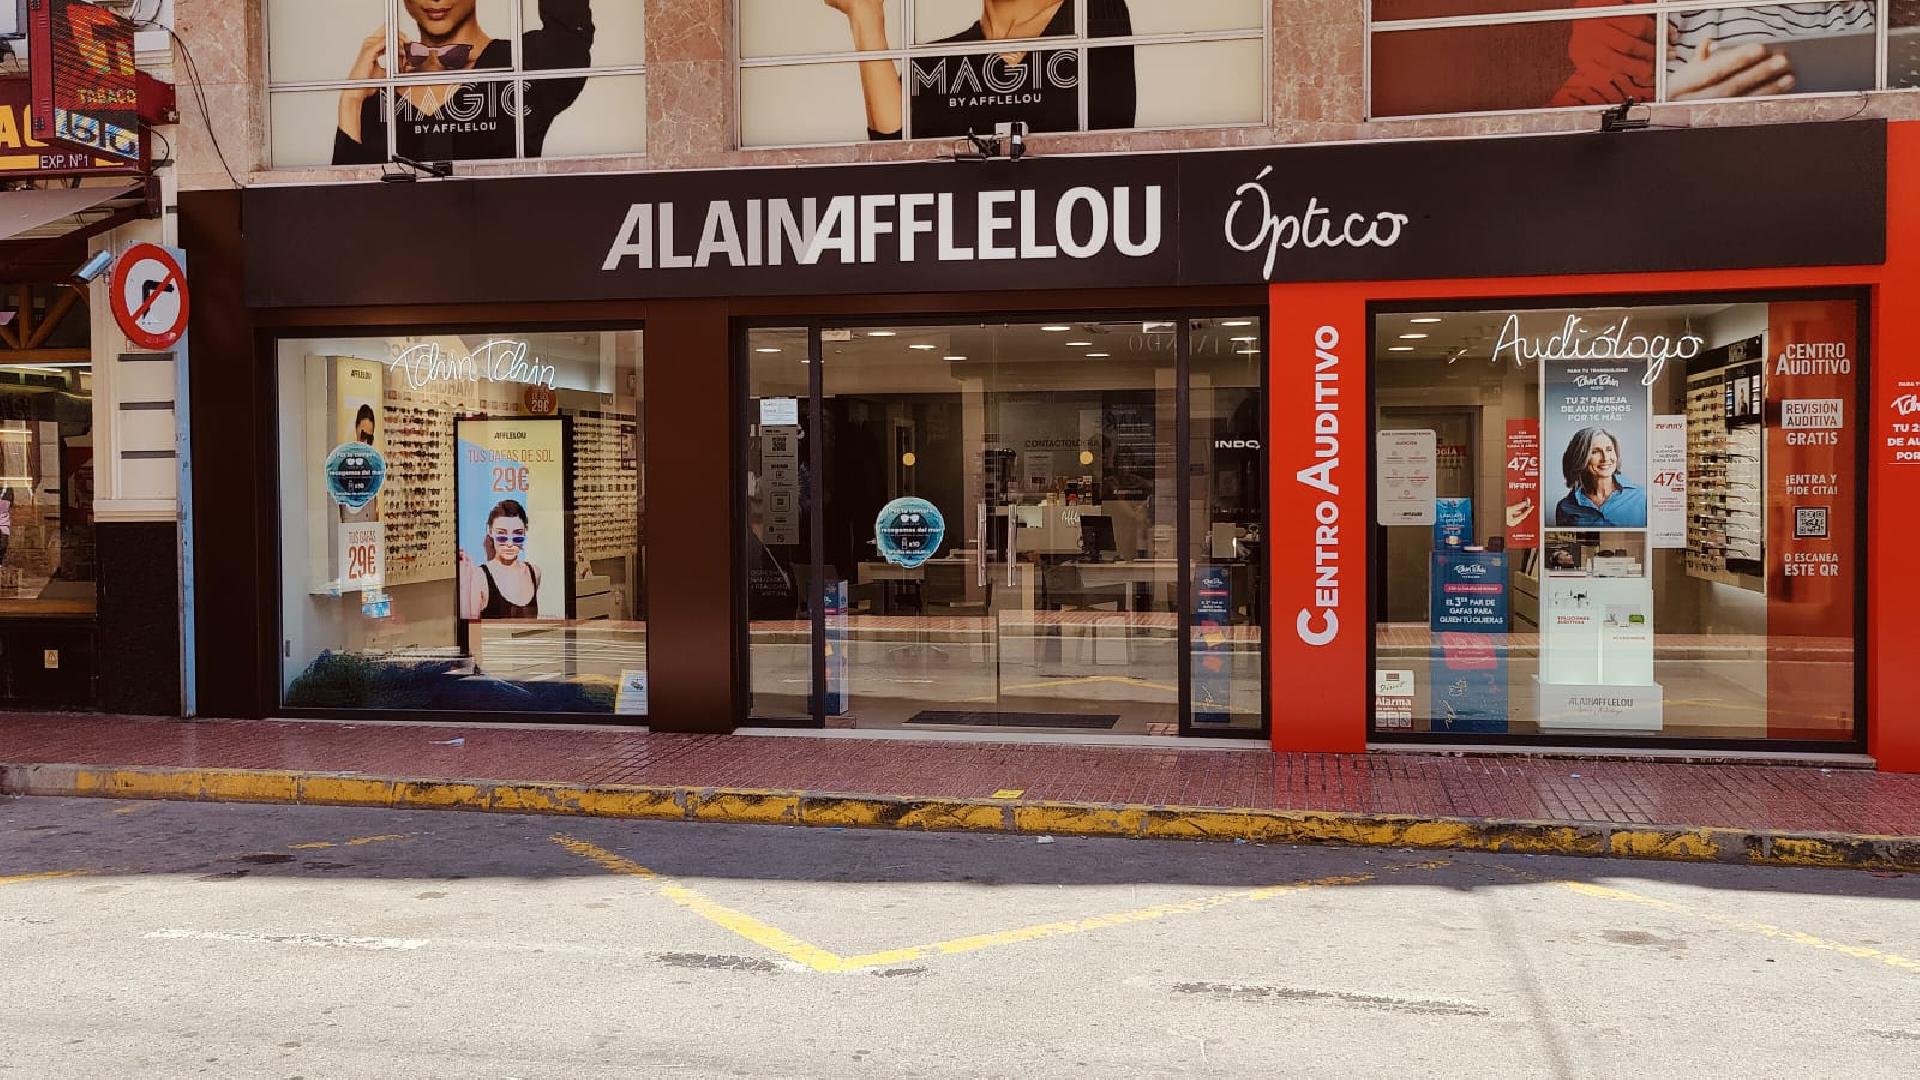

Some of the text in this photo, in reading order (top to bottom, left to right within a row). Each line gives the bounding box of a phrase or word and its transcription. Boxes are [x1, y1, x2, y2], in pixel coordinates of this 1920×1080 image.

[912, 50, 1078, 96] MAGIC
[380, 80, 532, 122] MAGIC
[949, 93, 1042, 107] BY AFFLELOU
[414, 121, 497, 135] BY AFFLELOU
[41, 156, 67, 169] EXP.
[1225, 165, 1409, 280] Óptico
[1491, 314, 1704, 386] Audiólogo
[1785, 342, 1845, 359] CENTRO
[1775, 353, 1851, 376] AUDITIVO
[1591, 396, 1628, 405] PAREJA
[1785, 401, 1838, 415] REVISIÓN
[1787, 415, 1838, 427] AUDITIVA
[1892, 423, 1909, 433] TU
[1785, 432, 1838, 446] GRATIS
[1888, 437, 1904, 446] DE
[469, 448, 555, 463] TUS GAFAS DE SOL
[1507, 456, 1538, 471] 47€
[493, 466, 530, 492] 29€
[1653, 472, 1684, 487] 47€
[1785, 474, 1838, 485] ¡ENTRA Y
[1785, 486, 1838, 496] PIDE CITA!
[348, 545, 376, 579] 29€
[1784, 553, 1838, 562] O ESCANEA
[1784, 564, 1838, 577] ESTE QR
[1449, 607, 1492, 615] GAFAS PARA
[1472, 616, 1503, 624] QUIERAS
[1376, 696, 1412, 706] Alarma
